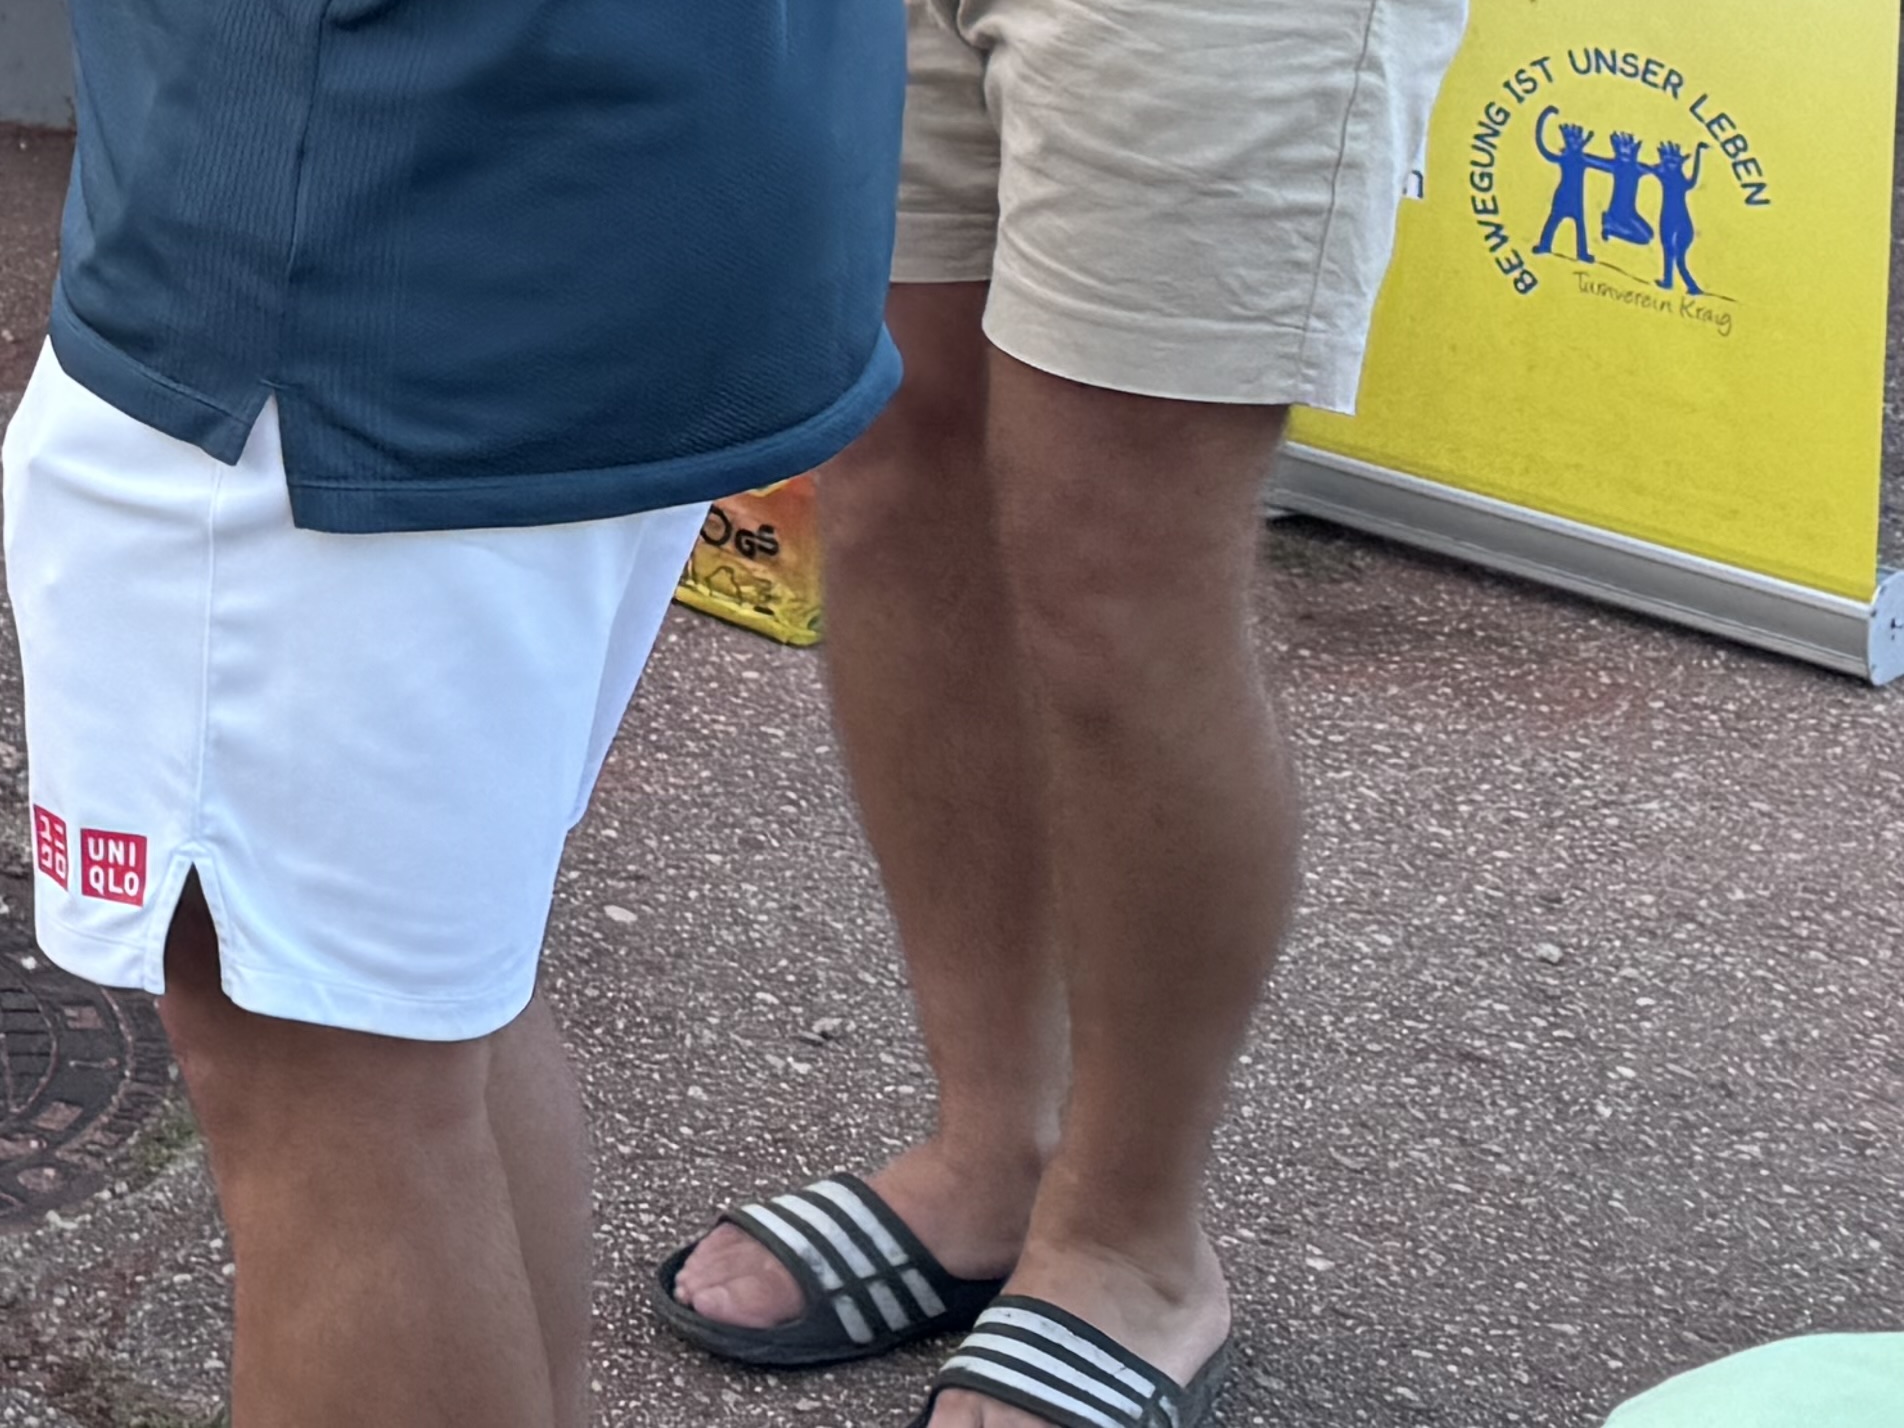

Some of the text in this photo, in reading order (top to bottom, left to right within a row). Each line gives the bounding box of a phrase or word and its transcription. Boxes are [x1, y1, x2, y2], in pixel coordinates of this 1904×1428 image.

[1469, 47, 1772, 295] BEWEGUNG IST UNSER LEBEN
[1679, 296, 1734, 338] Kraig
[87, 836, 137, 868] UNI
[88, 864, 140, 897] QLO
